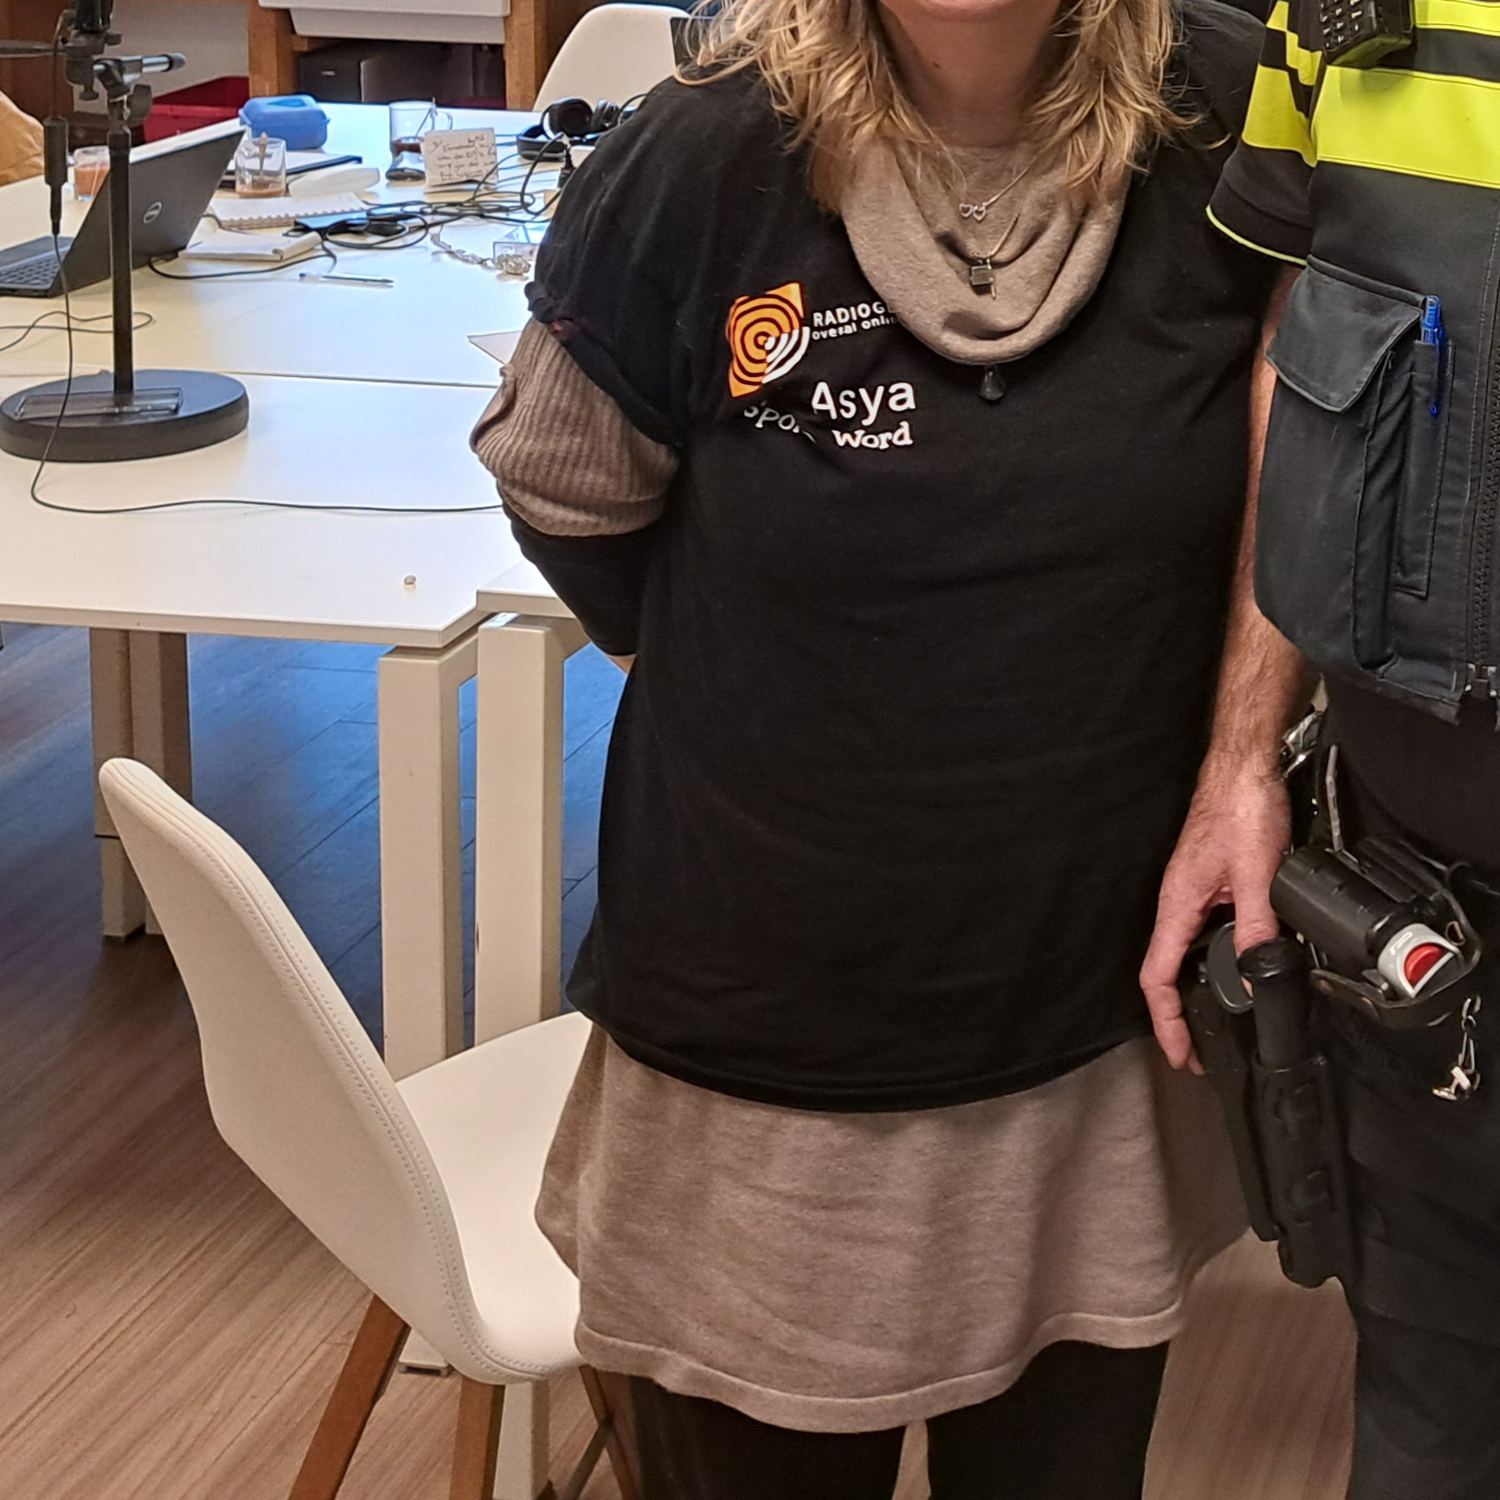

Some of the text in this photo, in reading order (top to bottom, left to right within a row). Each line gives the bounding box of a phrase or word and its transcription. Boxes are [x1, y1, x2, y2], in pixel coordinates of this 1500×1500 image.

[812, 301, 886, 328] RADIOG
[811, 322, 858, 340] overal
[811, 381, 917, 427] Asya
